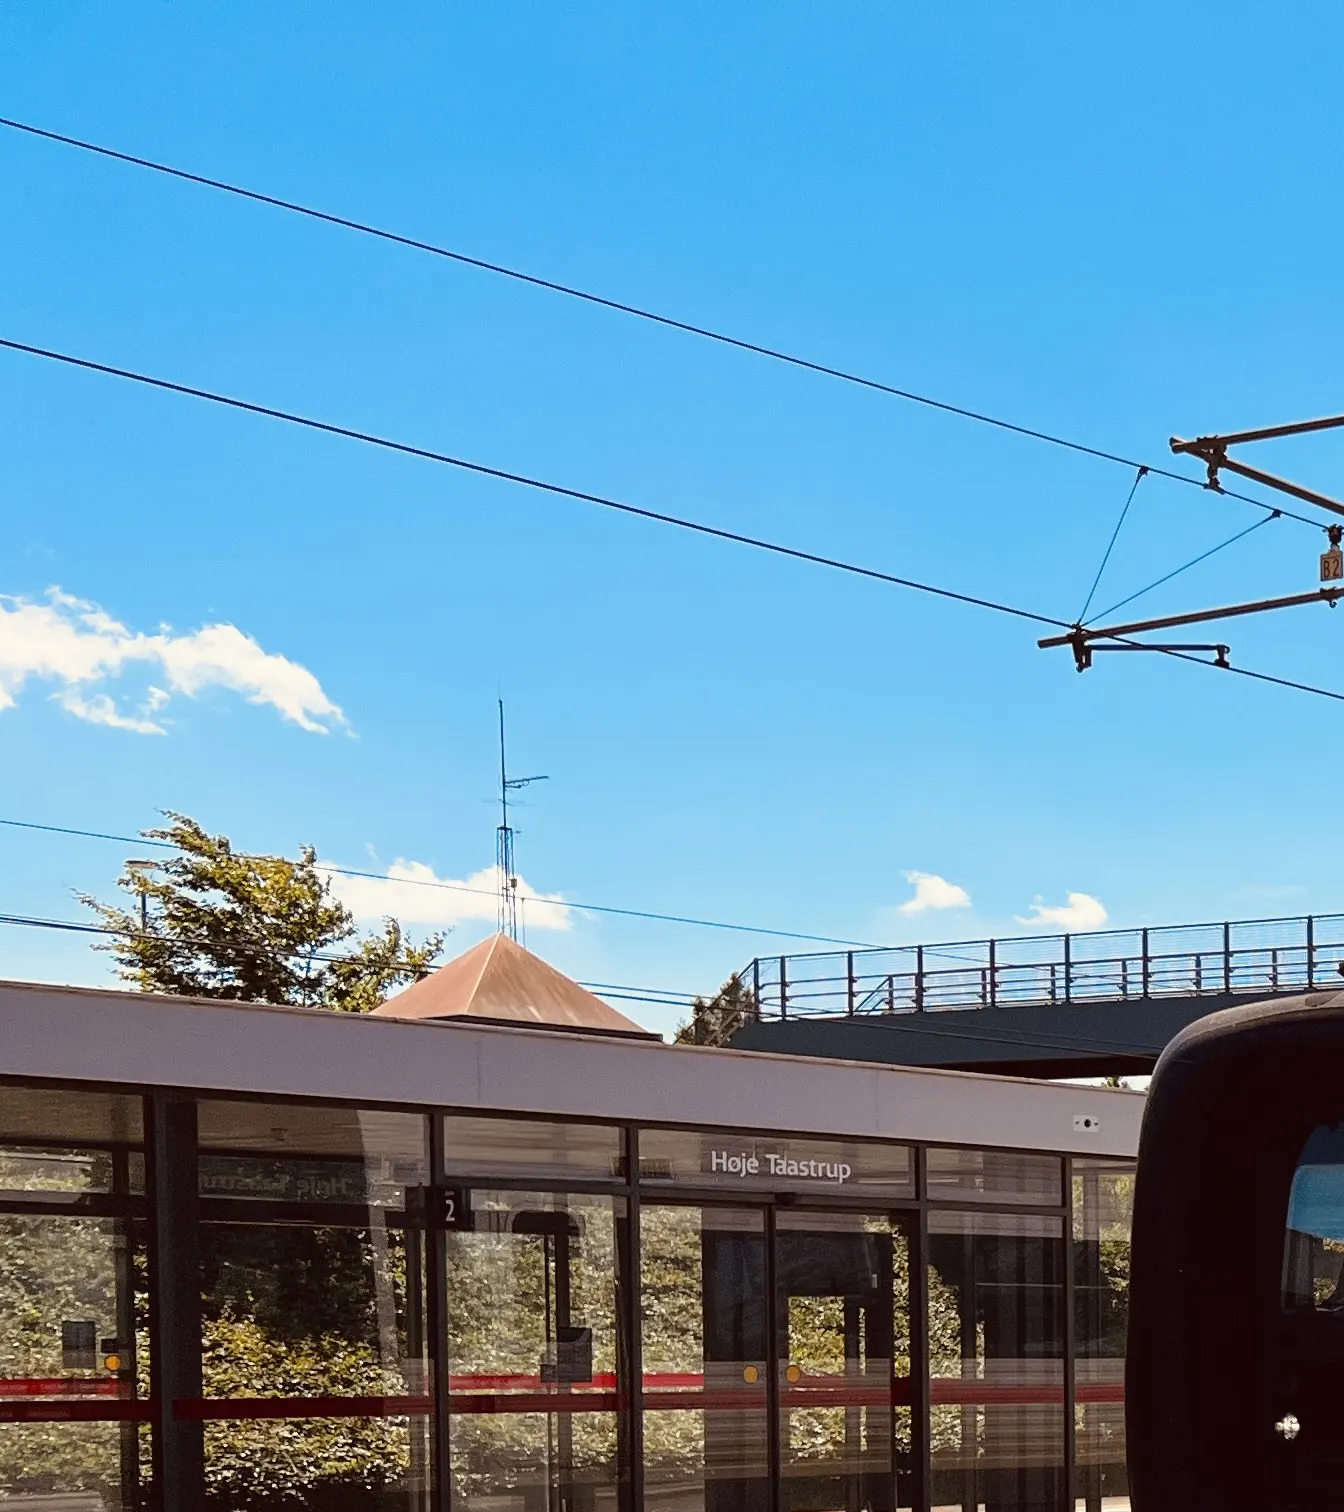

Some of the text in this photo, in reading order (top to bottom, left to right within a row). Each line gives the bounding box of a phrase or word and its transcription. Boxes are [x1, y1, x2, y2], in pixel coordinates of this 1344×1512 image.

[1323, 559, 1340, 577] B2
[711, 1150, 851, 1184] Høje Taastrup
[445, 1199, 456, 1222] 2
